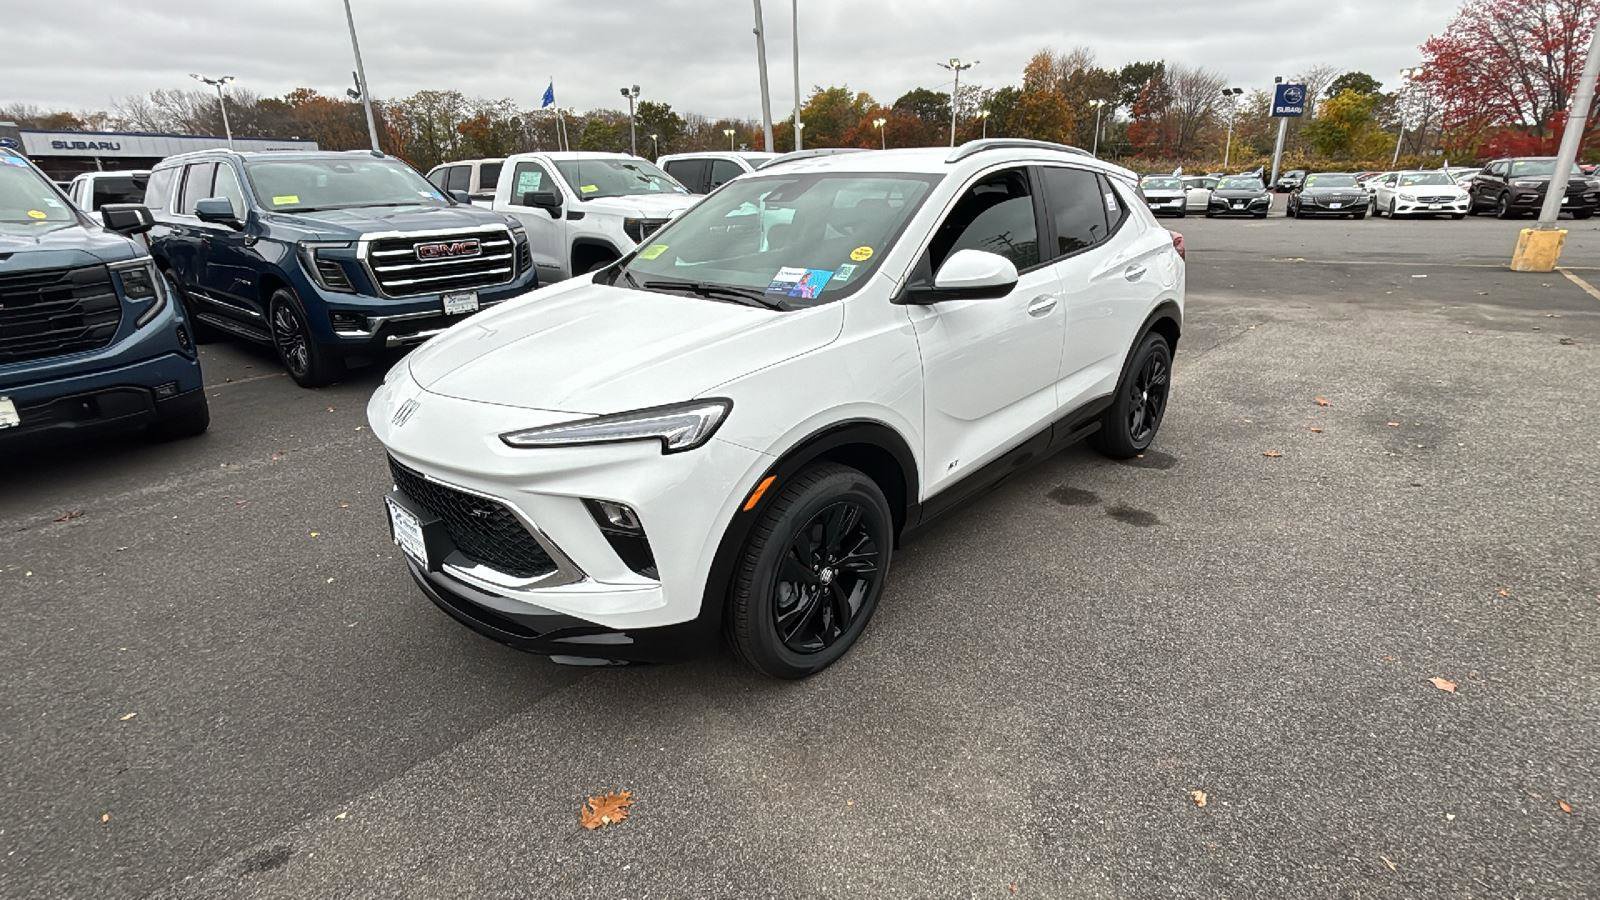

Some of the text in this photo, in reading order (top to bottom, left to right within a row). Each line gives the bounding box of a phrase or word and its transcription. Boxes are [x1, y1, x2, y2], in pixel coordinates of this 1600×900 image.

[1276, 106, 1303, 114] SUBARU
[51, 140, 121, 151] SUBARU
[419, 241, 479, 258] GMC
